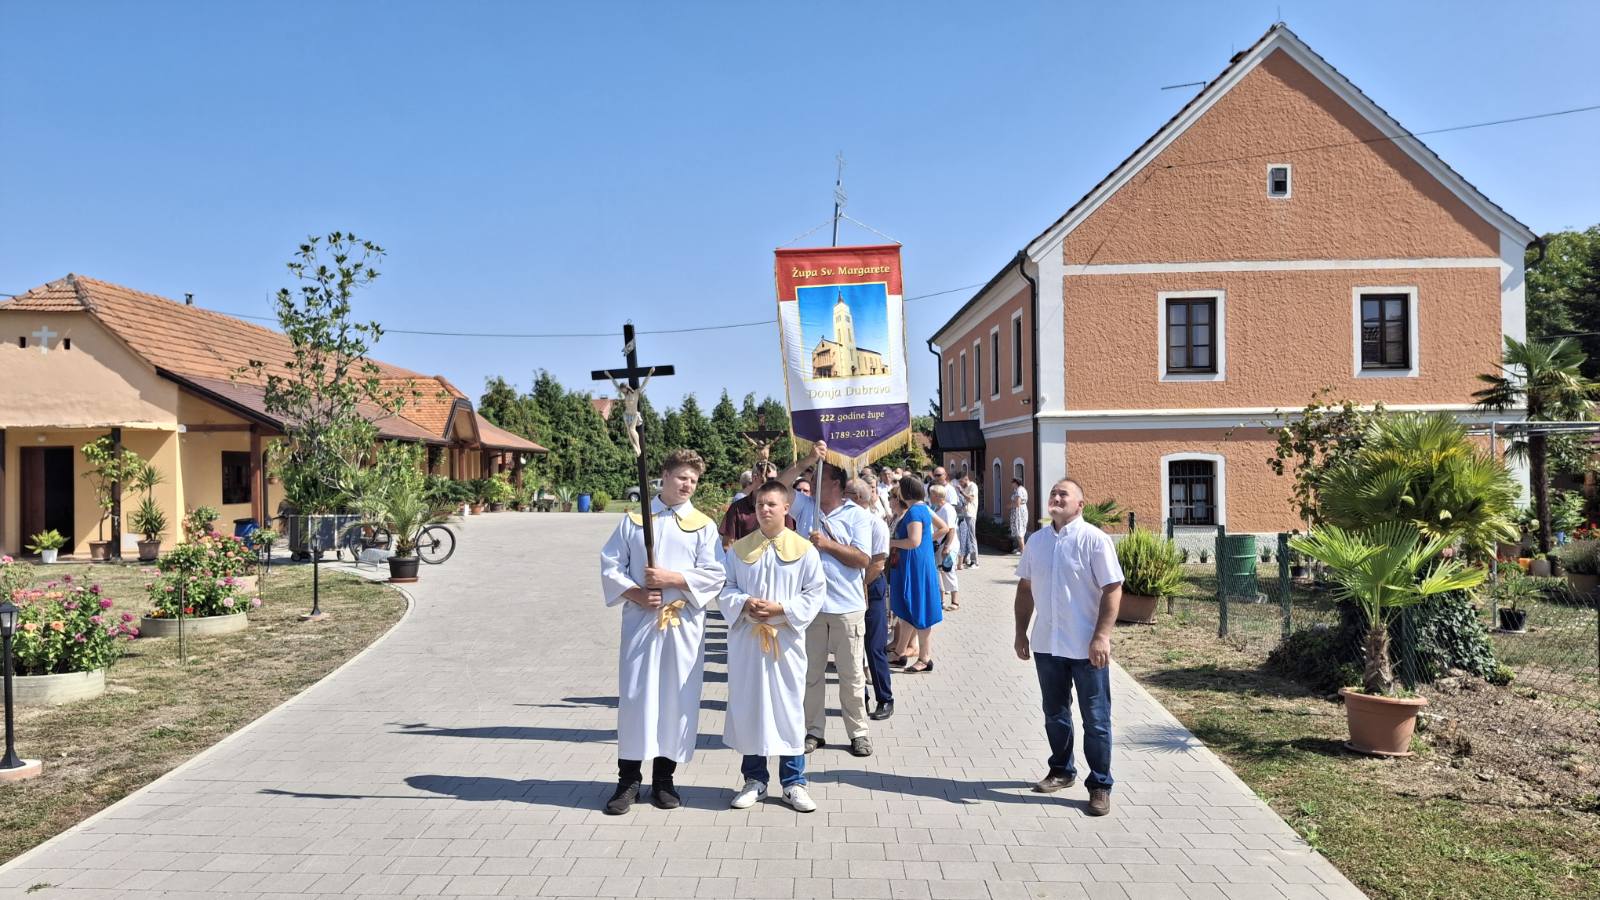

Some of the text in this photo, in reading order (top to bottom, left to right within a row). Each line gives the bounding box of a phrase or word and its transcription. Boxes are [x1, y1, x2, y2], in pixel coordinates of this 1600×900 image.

[792, 265, 890, 278] Župa Sv. Margarete
[809, 385, 891, 400] Donja Dubrava
[820, 410, 885, 423] 222 godine župe
